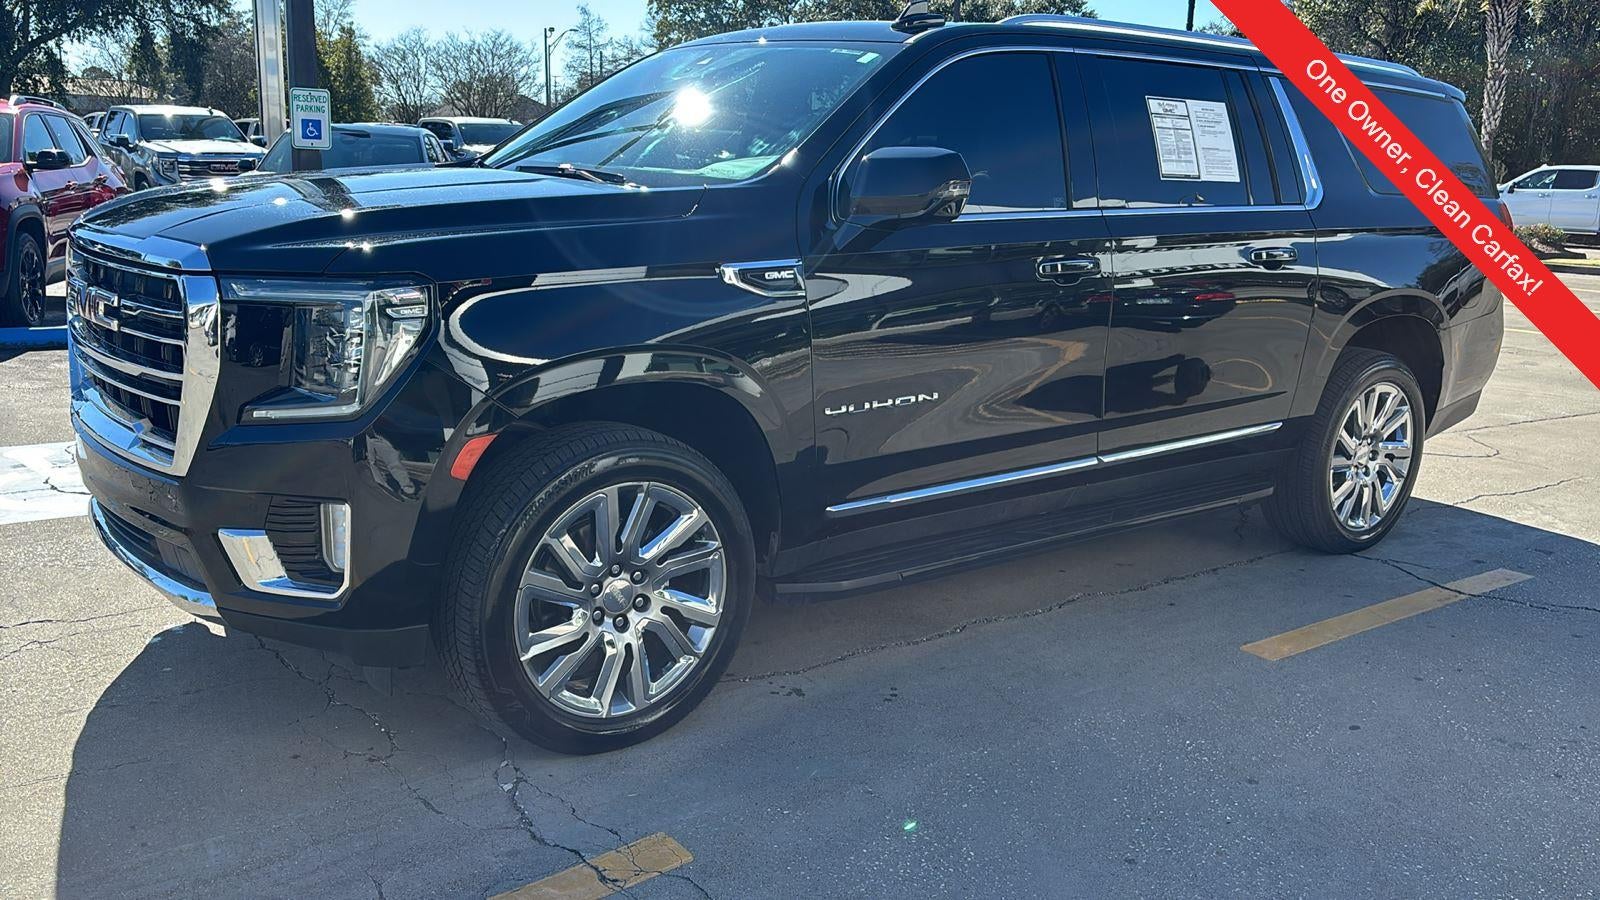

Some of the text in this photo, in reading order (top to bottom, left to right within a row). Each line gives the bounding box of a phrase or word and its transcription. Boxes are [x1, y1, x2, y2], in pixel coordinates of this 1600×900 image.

[293, 93, 328, 103] RESERVED
[296, 104, 326, 114] PARKING
[764, 270, 795, 280] GMC
[824, 391, 940, 415] YUKON
